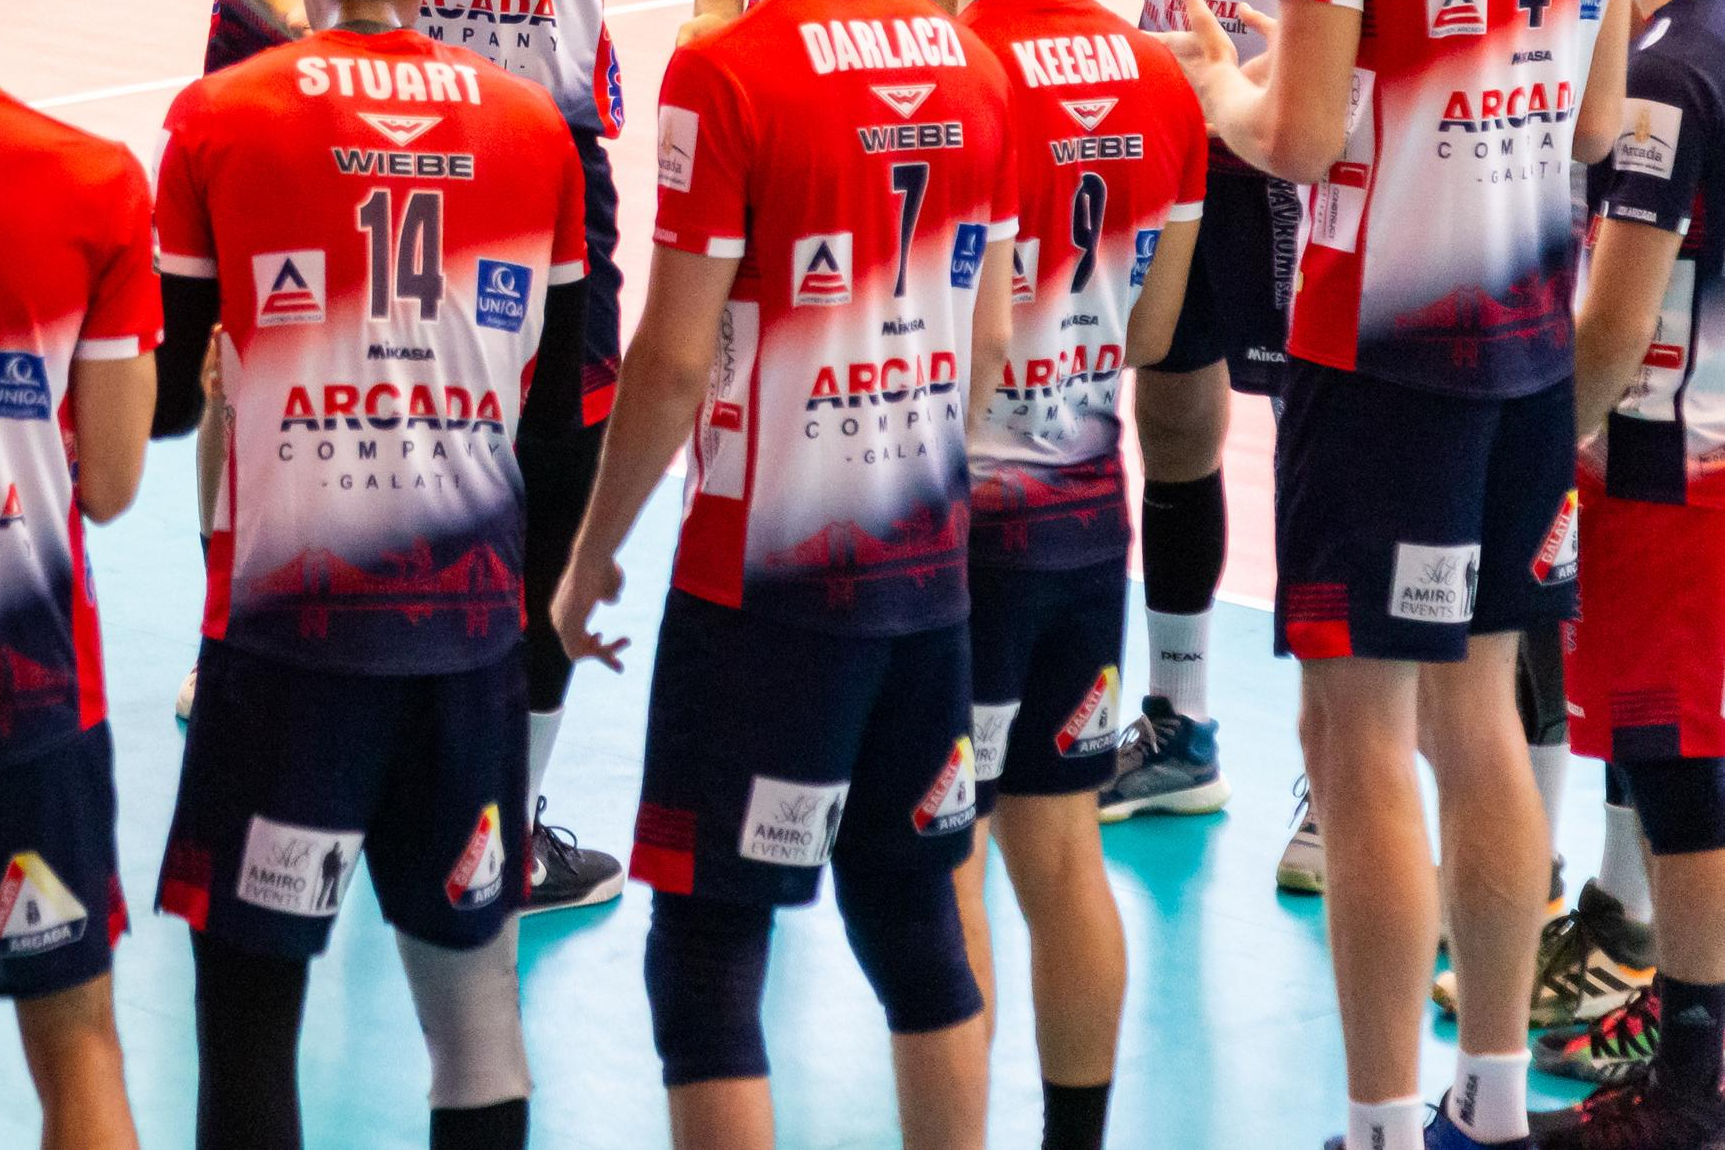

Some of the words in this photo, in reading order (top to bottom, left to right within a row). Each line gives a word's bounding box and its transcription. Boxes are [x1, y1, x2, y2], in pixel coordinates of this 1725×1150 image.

[799, 15, 967, 75] DARLACZI
[1011, 33, 1140, 88] KEEGAN
[297, 55, 483, 106] STUART
[856, 121, 965, 154] WIEBE
[1622, 144, 1663, 163] Arcada
[331, 146, 475, 181] WIEBE
[891, 160, 931, 299] 7
[1071, 170, 1108, 295] 9
[355, 187, 447, 325] 14
[478, 296, 524, 319] UNIQA
[805, 350, 961, 412] ARCAD
[279, 383, 505, 435] ARCADA
[1399, 602, 1455, 619] EVENTS
[1401, 586, 1456, 605] AMIRO
[1160, 651, 1205, 663] PEAK
[750, 842, 810, 860] EVENTS
[755, 823, 814, 847] AMIRO
[248, 864, 307, 894] AMIRO
